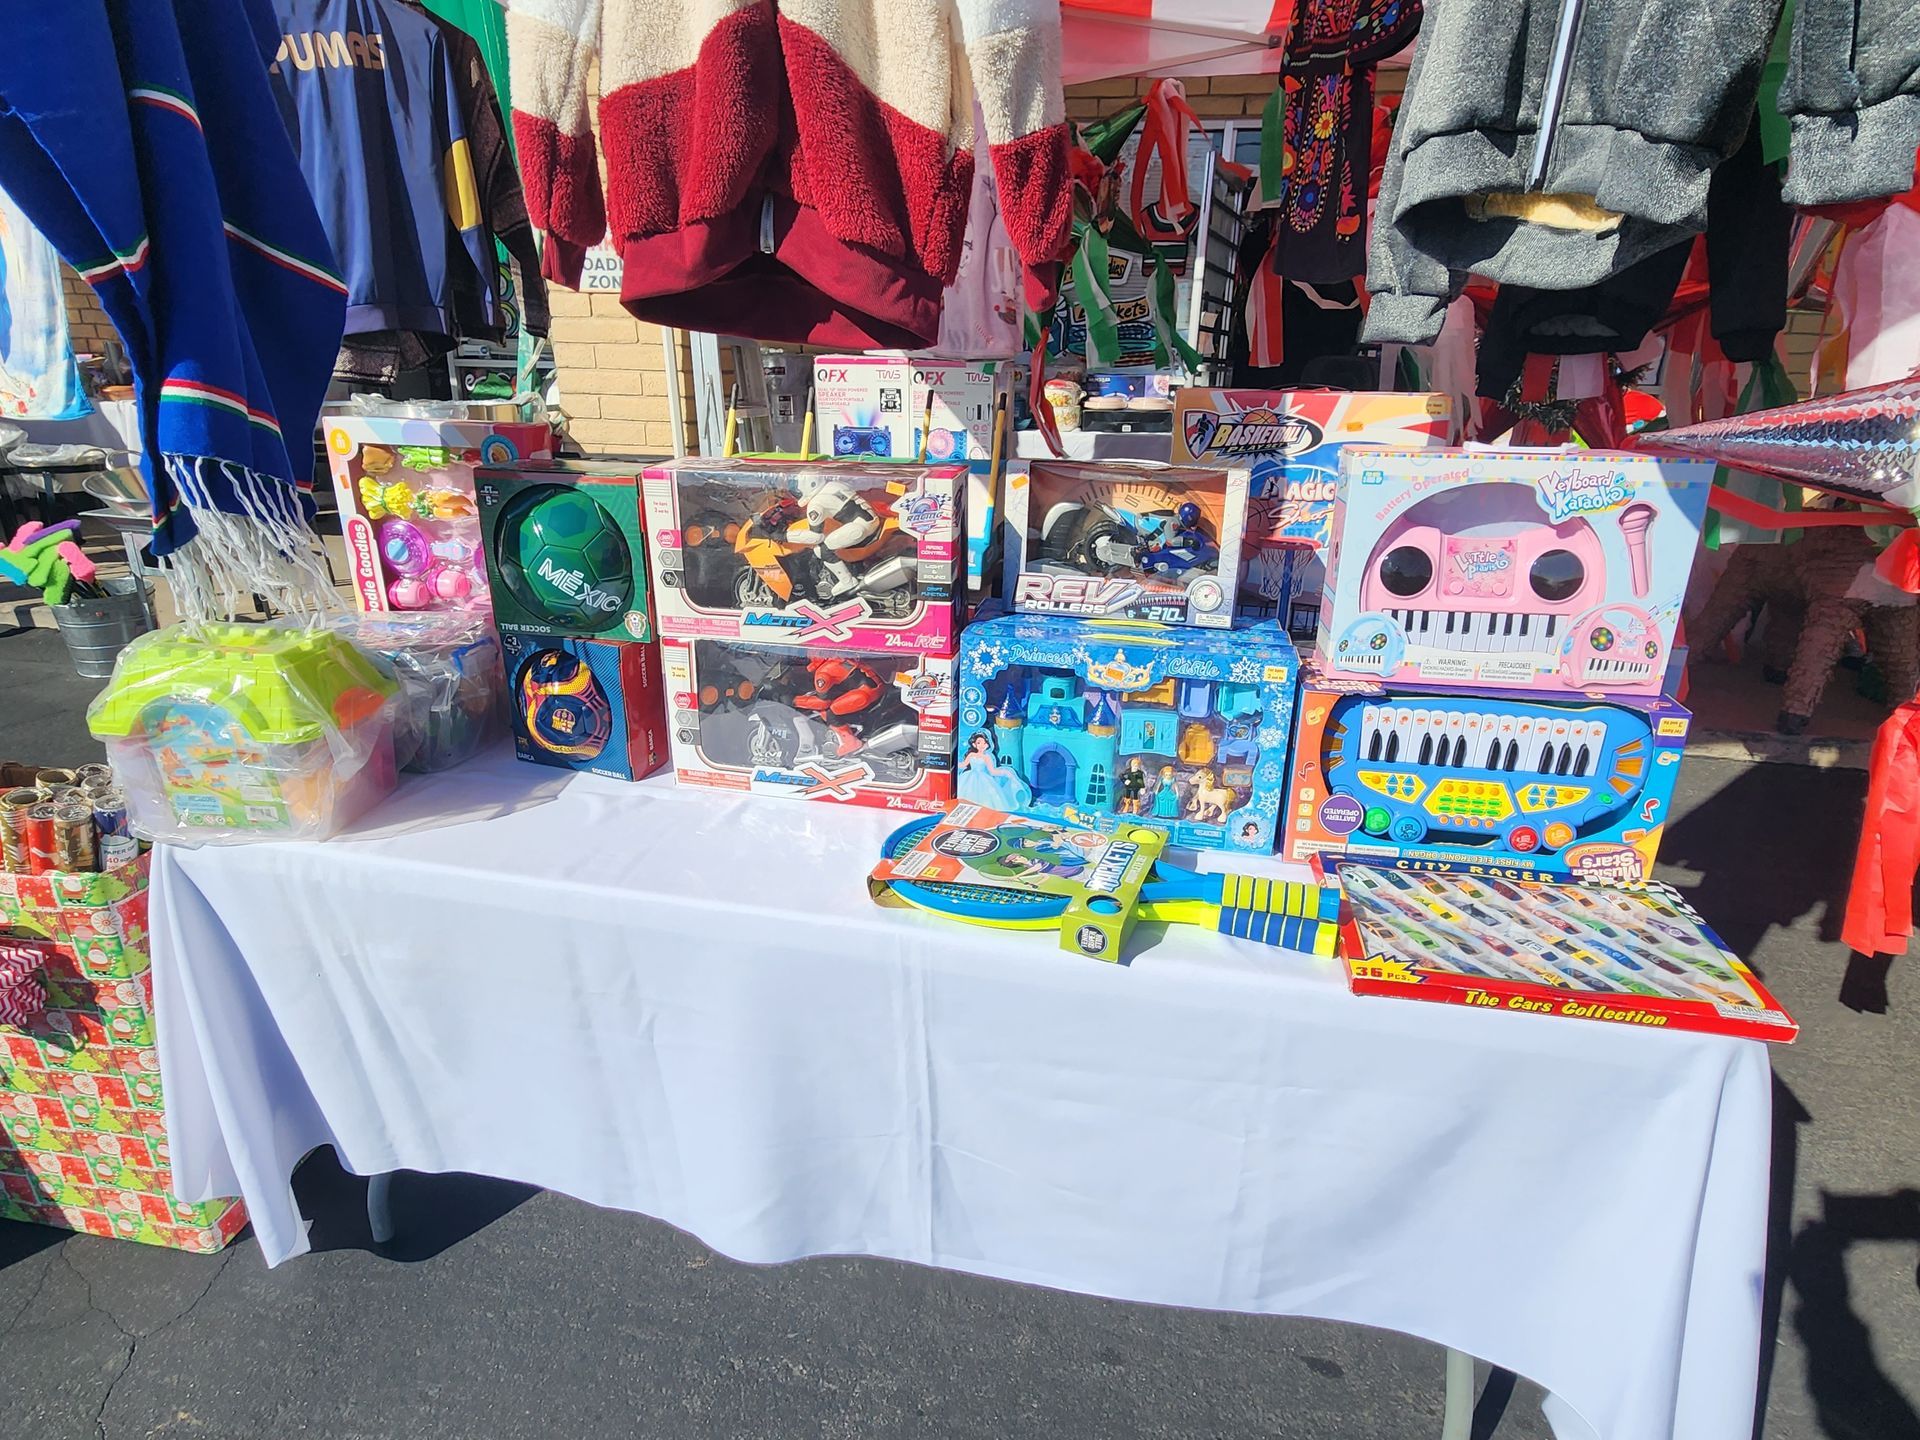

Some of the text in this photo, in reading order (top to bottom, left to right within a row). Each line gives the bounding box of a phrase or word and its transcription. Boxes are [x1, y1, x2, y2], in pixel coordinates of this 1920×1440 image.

[583, 257, 623, 271] OADI
[588, 274, 622, 289] ZON
[817, 368, 848, 383] QFX
[913, 371, 946, 386] QFX
[1375, 489, 1412, 521] Battery
[1413, 468, 1470, 492] Operated
[1538, 469, 1614, 506] Keyboard
[1554, 485, 1625, 519] Karaoke
[1268, 502, 1335, 531] Sho
[537, 557, 624, 612] MÉXIC
[1015, 574, 1130, 605] REV
[1024, 599, 1107, 614] ROLLERS
[501, 623, 551, 633] SOCCER BALL
[1008, 645, 1220, 677] Princess Castle
[1079, 813, 1095, 824] Try
[1323, 807, 1360, 816] OPERATED
[1326, 814, 1356, 823] BATTERY
[1439, 853, 1494, 865] ELECTRONIC
[1496, 858, 1521, 867] FIRST
[1522, 860, 1535, 868] MY
[1582, 851, 1634, 871] Stars
[1396, 860, 1451, 872] CITY
[1469, 865, 1555, 883] RACER
[1355, 966, 1383, 978] 36
[1465, 990, 1668, 1027] The Cars Collection
